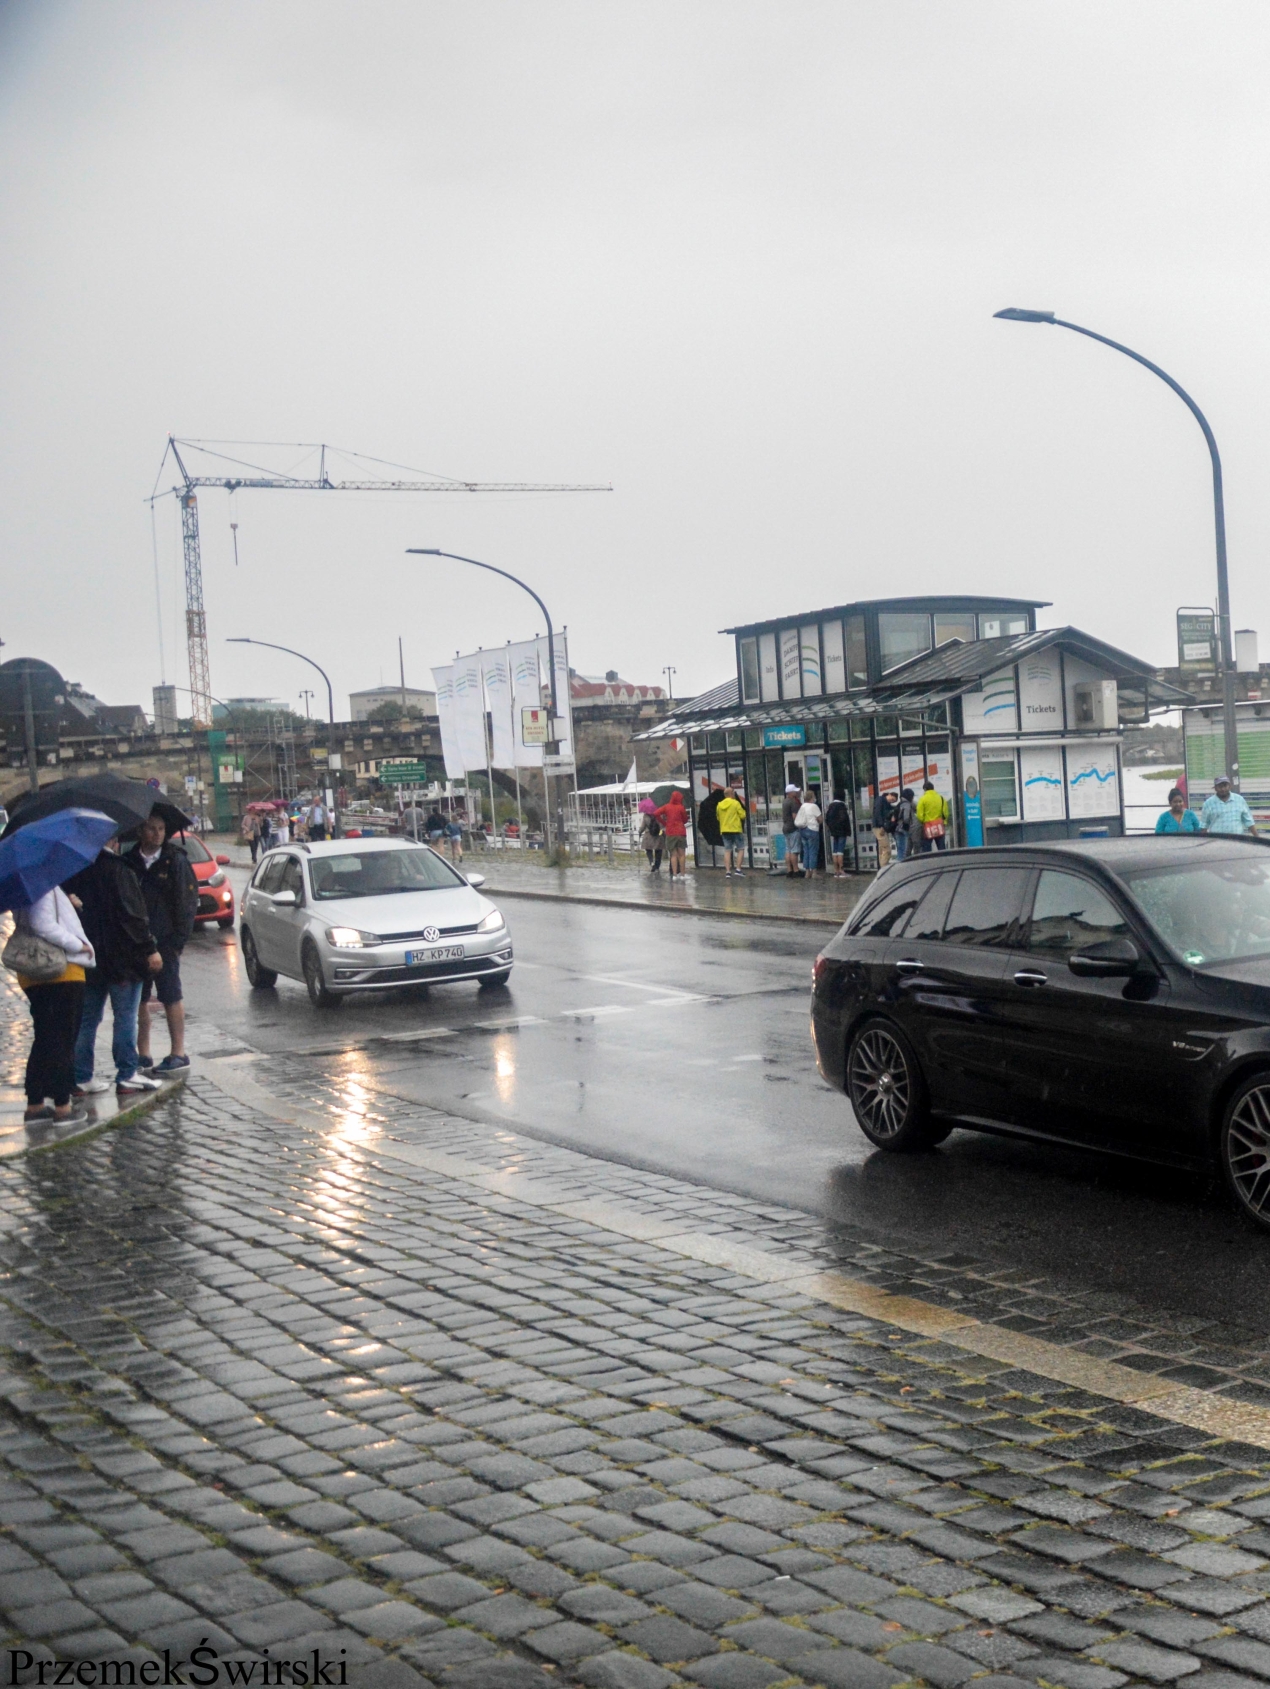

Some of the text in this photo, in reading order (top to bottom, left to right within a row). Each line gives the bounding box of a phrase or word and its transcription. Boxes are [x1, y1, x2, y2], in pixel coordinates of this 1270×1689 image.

[1196, 622, 1212, 630] CITY
[827, 654, 843, 663] Tickets
[1026, 704, 1057, 714] Tickets
[767, 731, 802, 741] Tickets
[412, 951, 425, 961] HZ
[431, 950, 443, 959] KP
